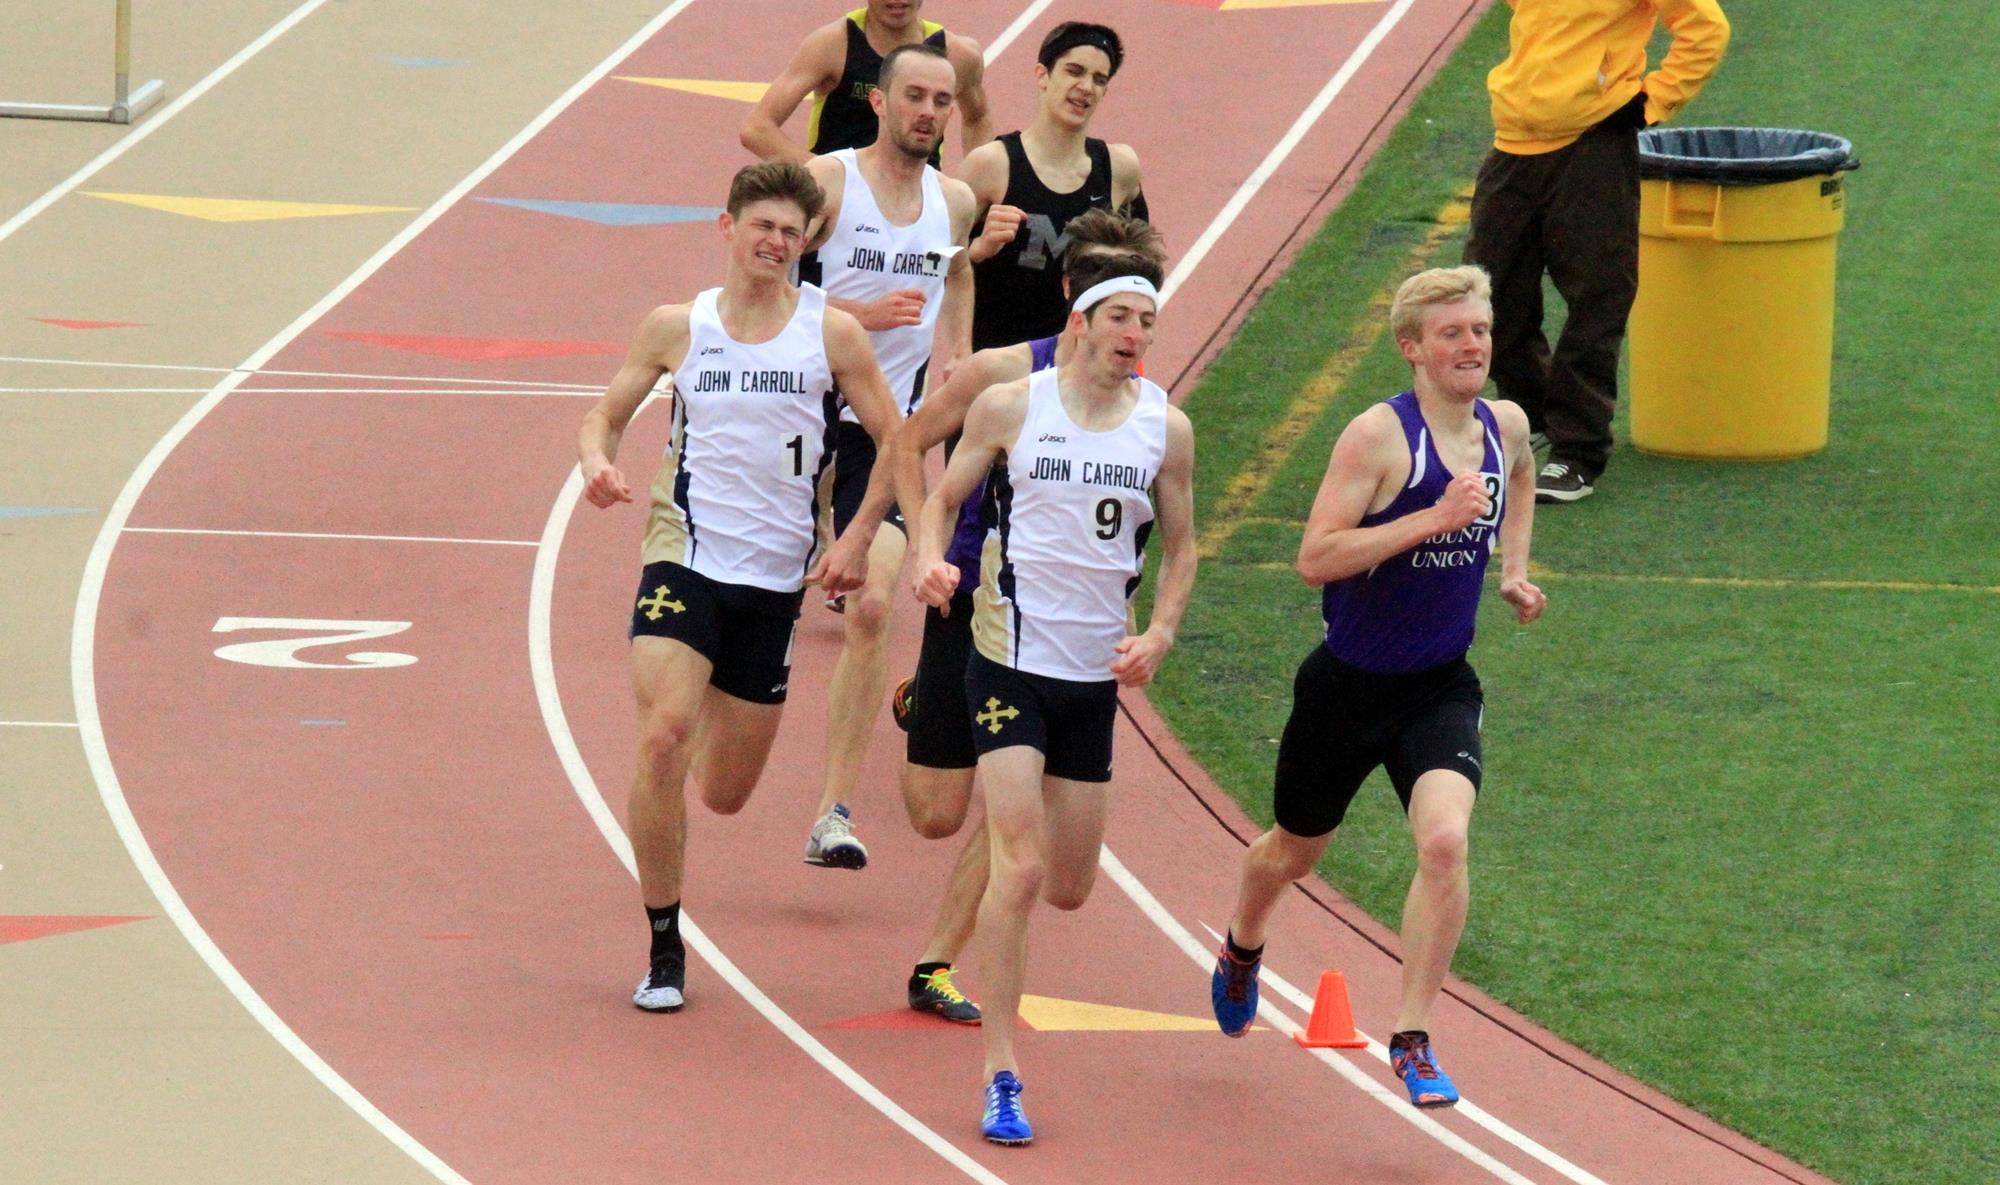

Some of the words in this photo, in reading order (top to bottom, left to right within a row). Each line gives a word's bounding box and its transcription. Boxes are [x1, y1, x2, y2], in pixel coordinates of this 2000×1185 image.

[847, 247, 886, 273] JOHN
[892, 252, 939, 278] CARR
[694, 370, 731, 393] JOHN
[741, 370, 807, 394] CARROLL
[786, 434, 803, 476] 1
[1029, 456, 1072, 482] JOHN
[1082, 461, 1147, 492] CARROLL
[1480, 476, 1500, 521] 3
[1095, 498, 1123, 541] 9
[1424, 526, 1488, 544] OUNT
[1411, 550, 1478, 568] UNION
[211, 616, 419, 669] 2
